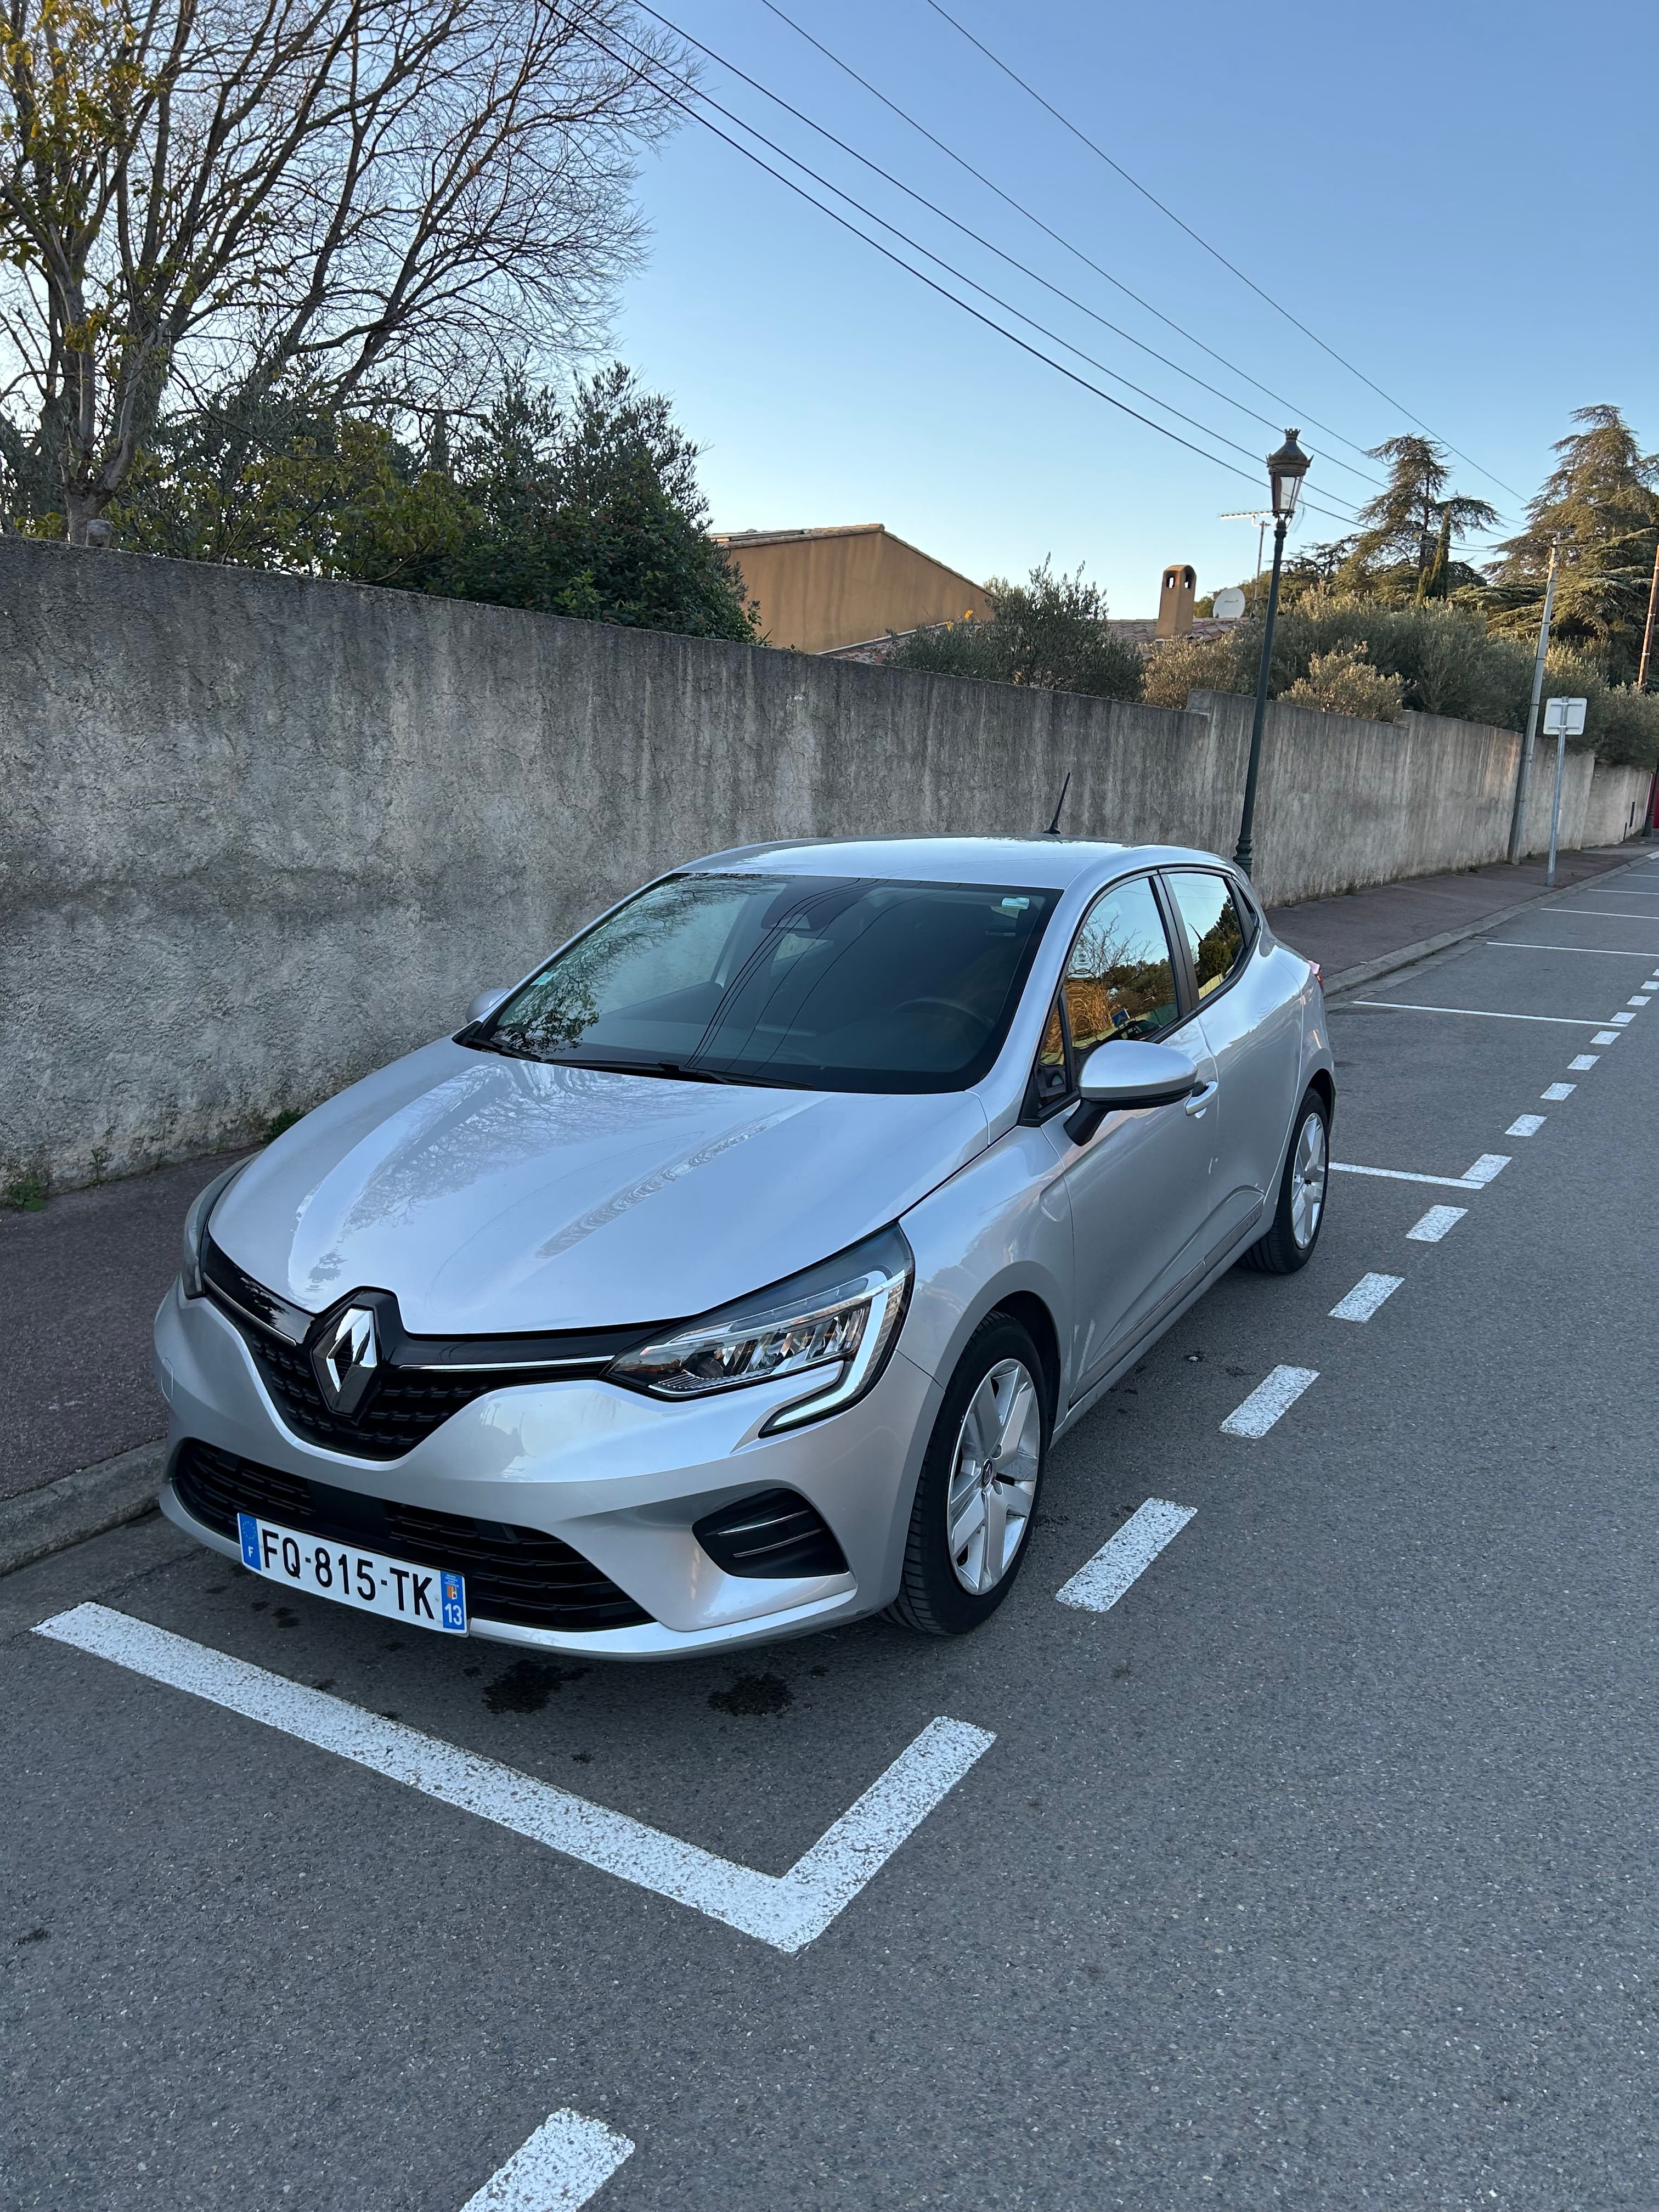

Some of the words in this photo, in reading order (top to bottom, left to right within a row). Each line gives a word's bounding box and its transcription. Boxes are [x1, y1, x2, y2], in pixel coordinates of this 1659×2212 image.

[248, 1545, 253, 1558] F
[262, 1528, 435, 1620] FQ-815-TK
[445, 1602, 462, 1625] 13
